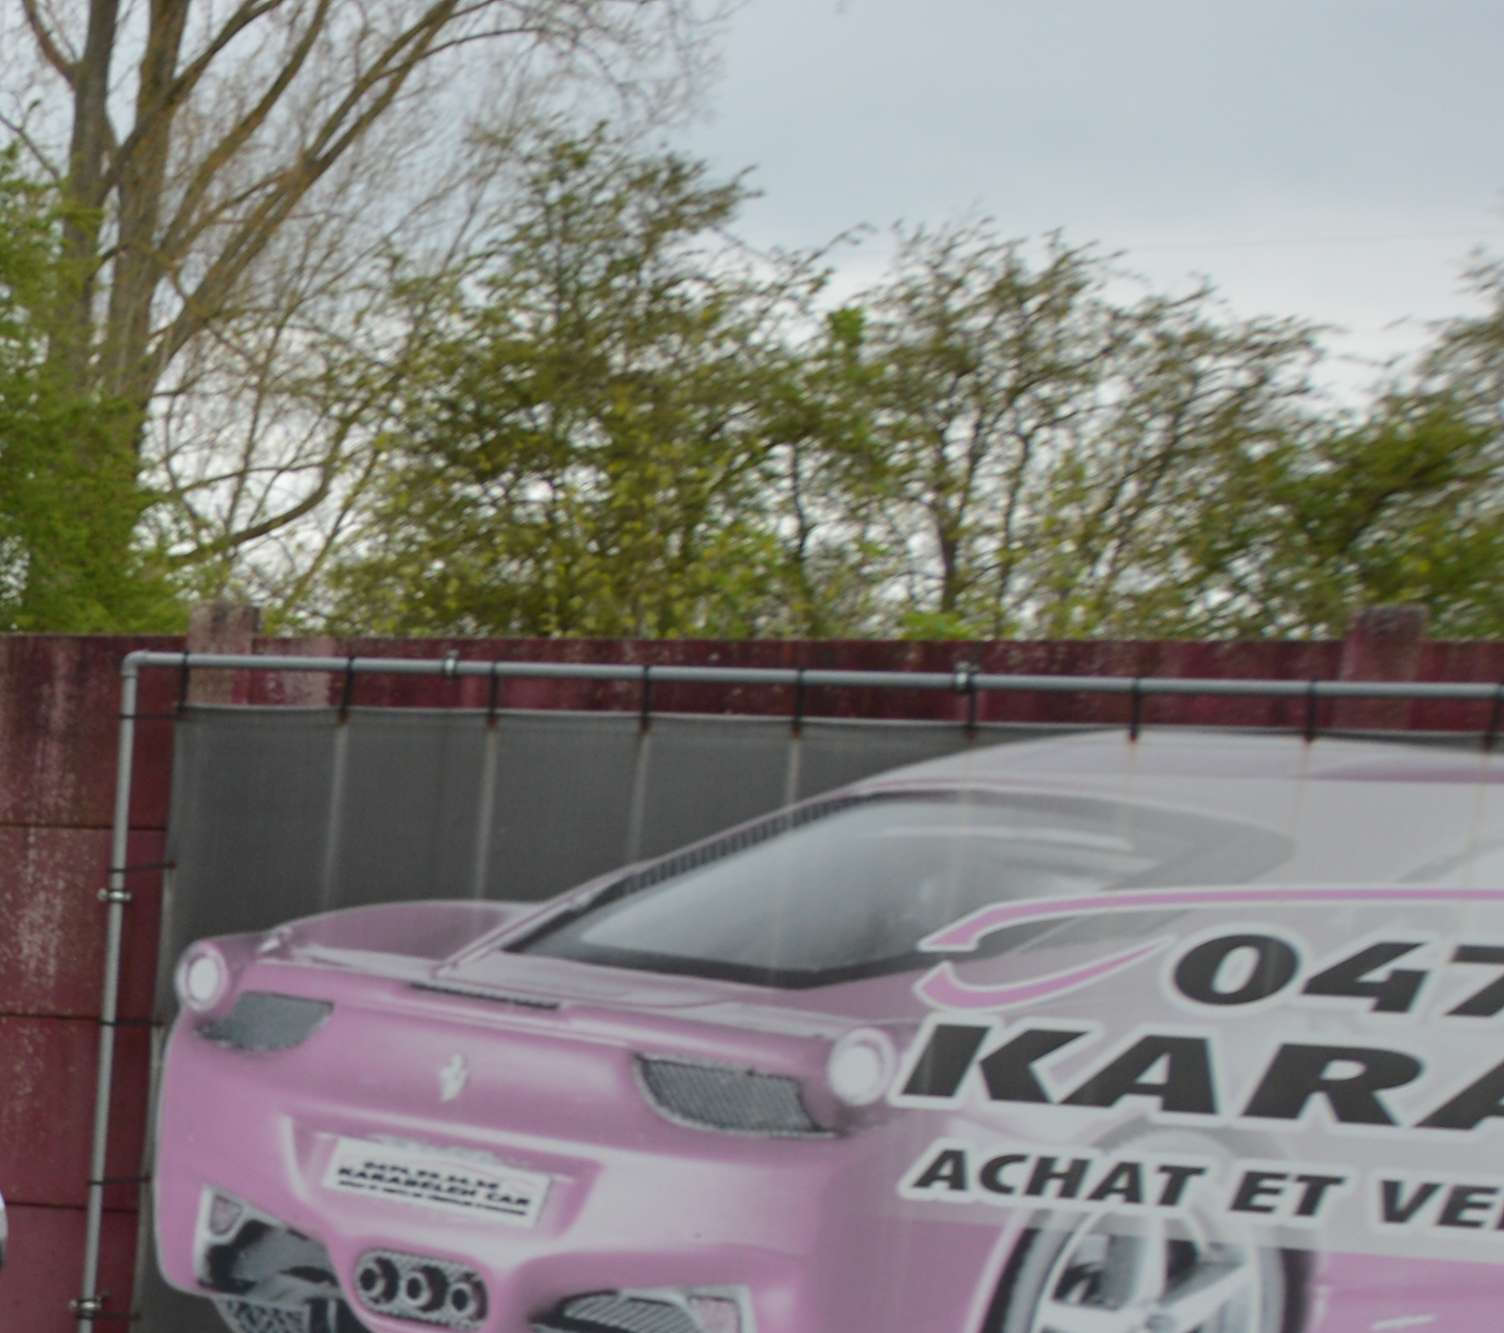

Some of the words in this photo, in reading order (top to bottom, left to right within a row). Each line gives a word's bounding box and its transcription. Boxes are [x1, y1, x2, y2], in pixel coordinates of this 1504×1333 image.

[912, 1148, 1207, 1207] ACHAT
[1229, 1170, 1346, 1219] ET
[1381, 1178, 1504, 1231] VE
